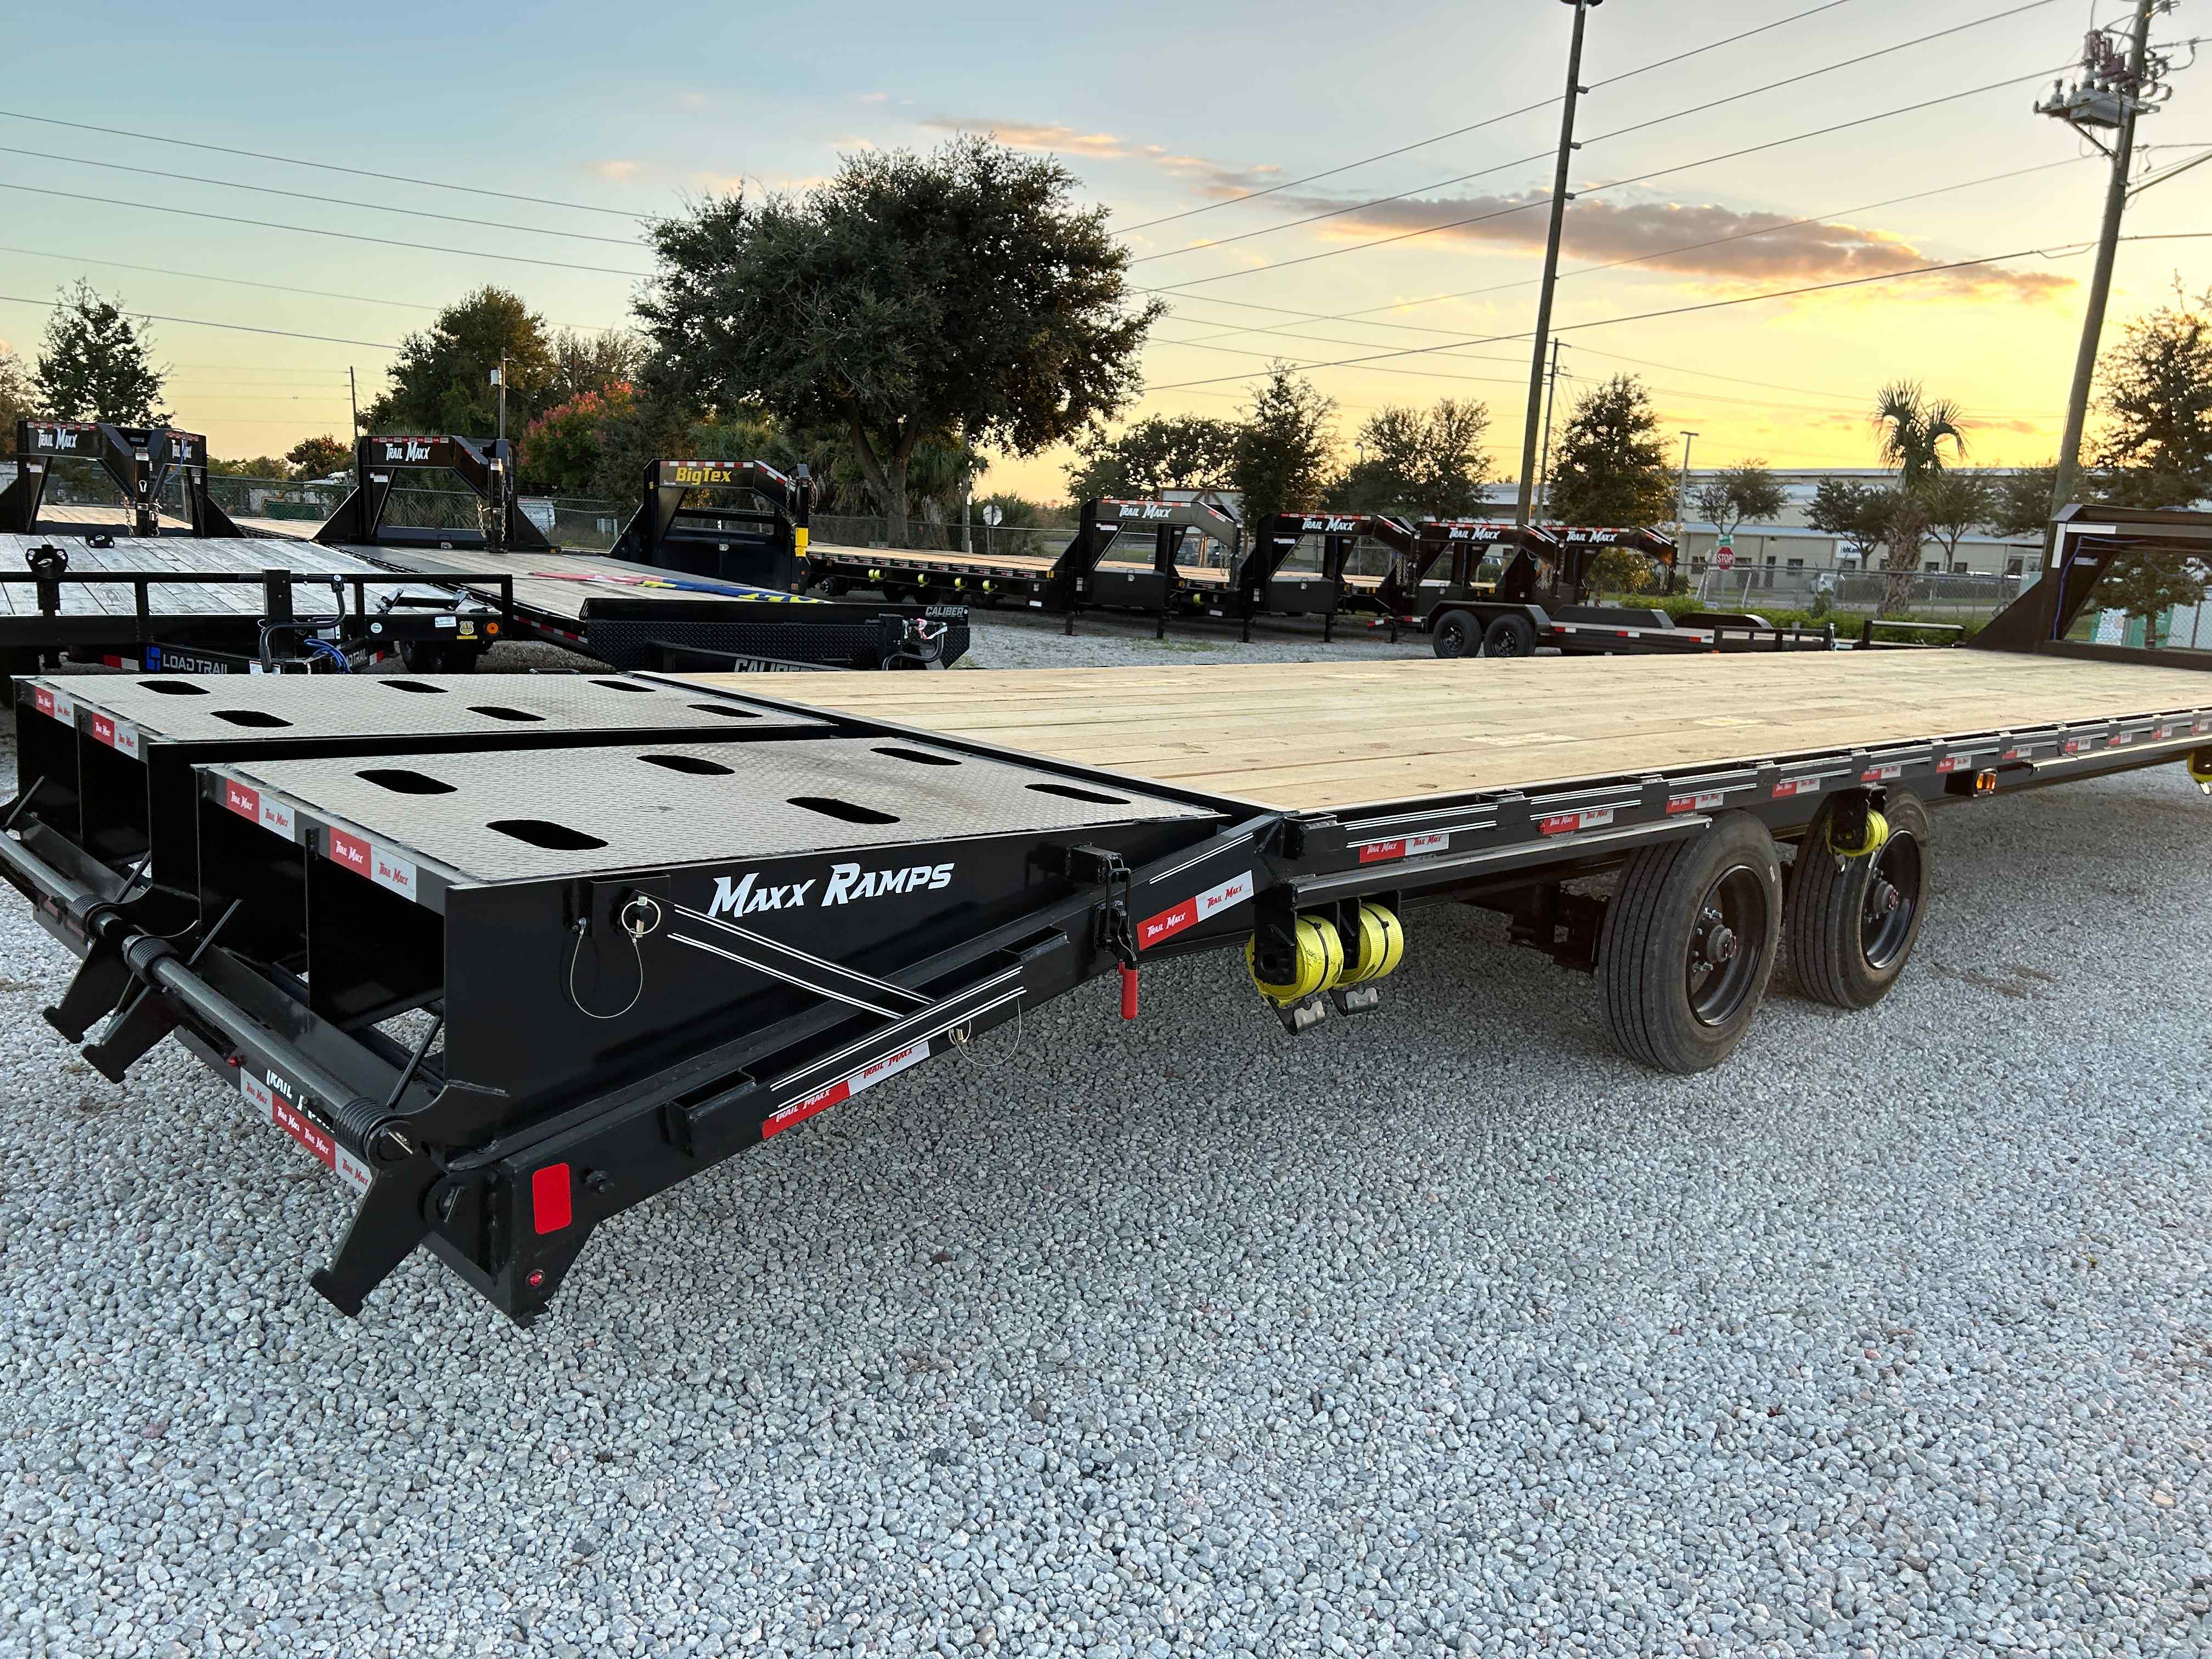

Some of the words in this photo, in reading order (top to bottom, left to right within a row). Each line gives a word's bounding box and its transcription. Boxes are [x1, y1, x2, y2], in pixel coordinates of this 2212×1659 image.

[37, 429, 53, 448] TRAIL
[55, 428, 78, 450] MAXX
[386, 443, 403, 461] TRAIL
[405, 442, 431, 462] MAXX
[1119, 504, 1139, 517] TRAIL
[1142, 503, 1172, 519] MAXX
[1302, 517, 1323, 531] TRAIL
[1325, 517, 1356, 532] MAXX
[1717, 553, 1733, 565] STOP
[925, 606, 964, 616] CALIBER
[707, 872, 816, 918] MAXX
[821, 862, 955, 907] RAMPS
[1207, 895, 1222, 909] TRAIL
[1224, 884, 1244, 901] MAXX
[1146, 923, 1164, 938] TRAIL
[1166, 912, 1186, 930] MAXX
